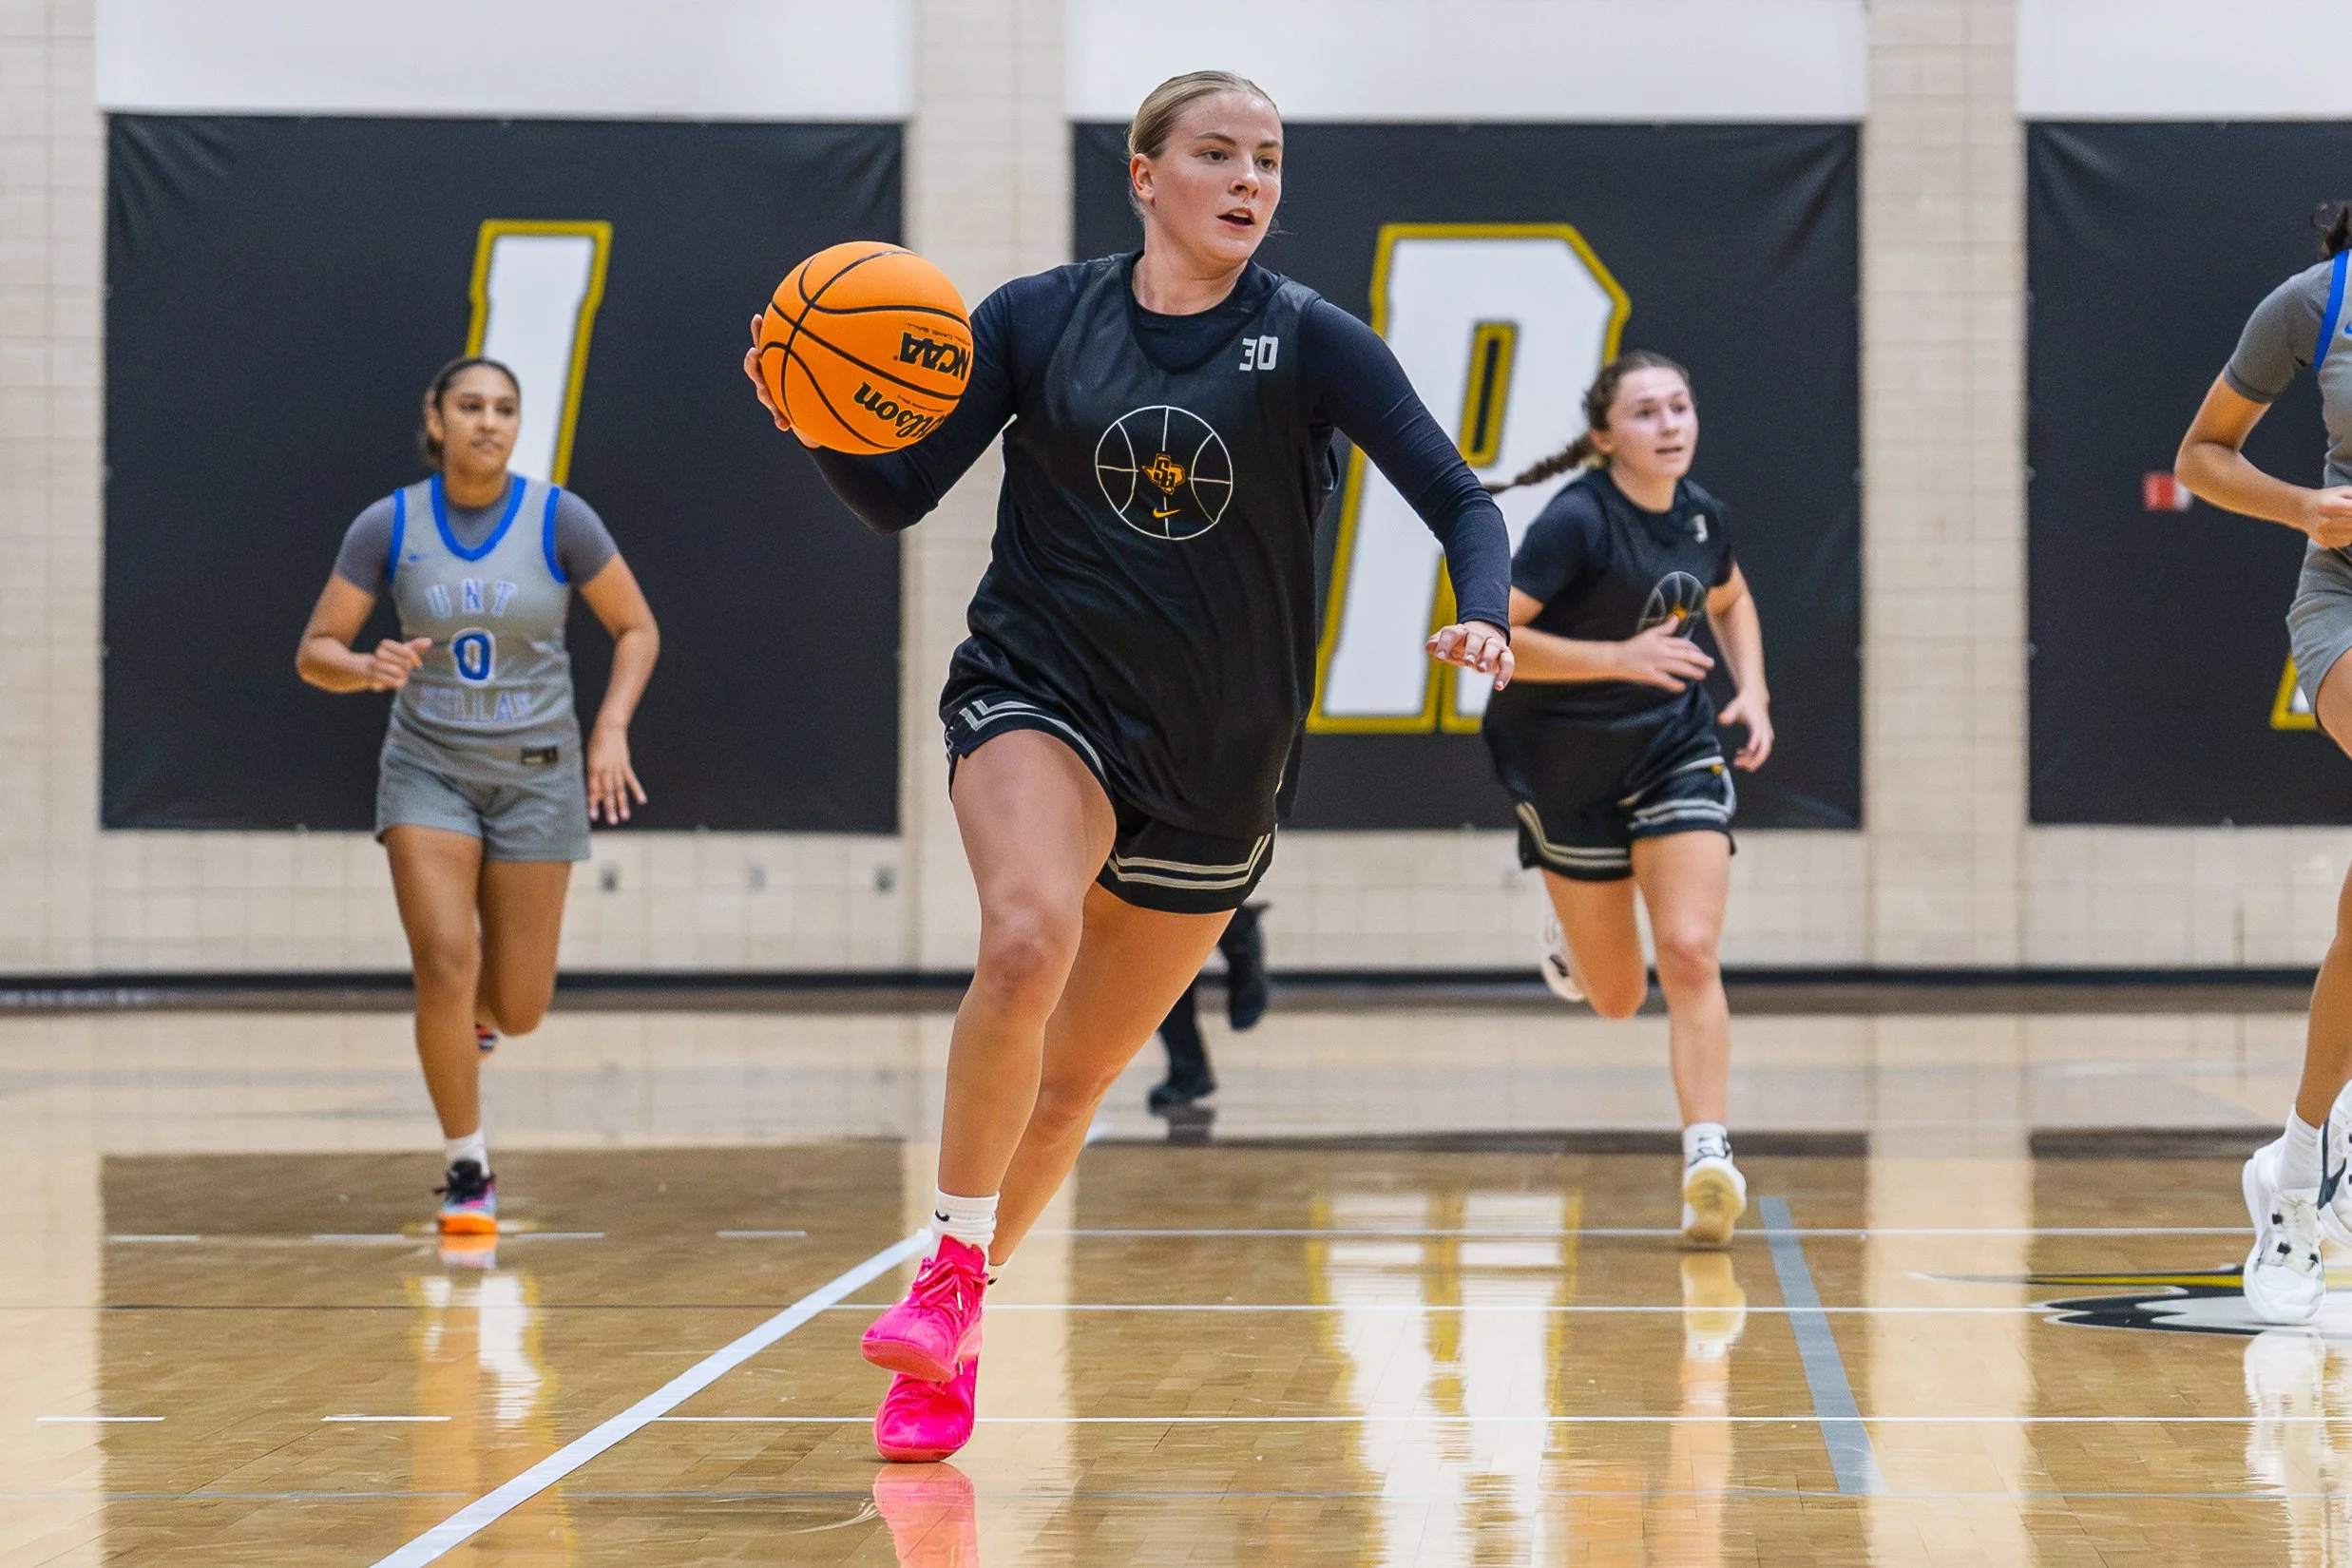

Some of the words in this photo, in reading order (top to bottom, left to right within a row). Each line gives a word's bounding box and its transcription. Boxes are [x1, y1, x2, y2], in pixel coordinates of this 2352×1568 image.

[899, 332, 971, 381] NCAA
[1239, 335, 1279, 372] 30
[425, 578, 518, 620] UNT
[450, 627, 497, 687] 0
